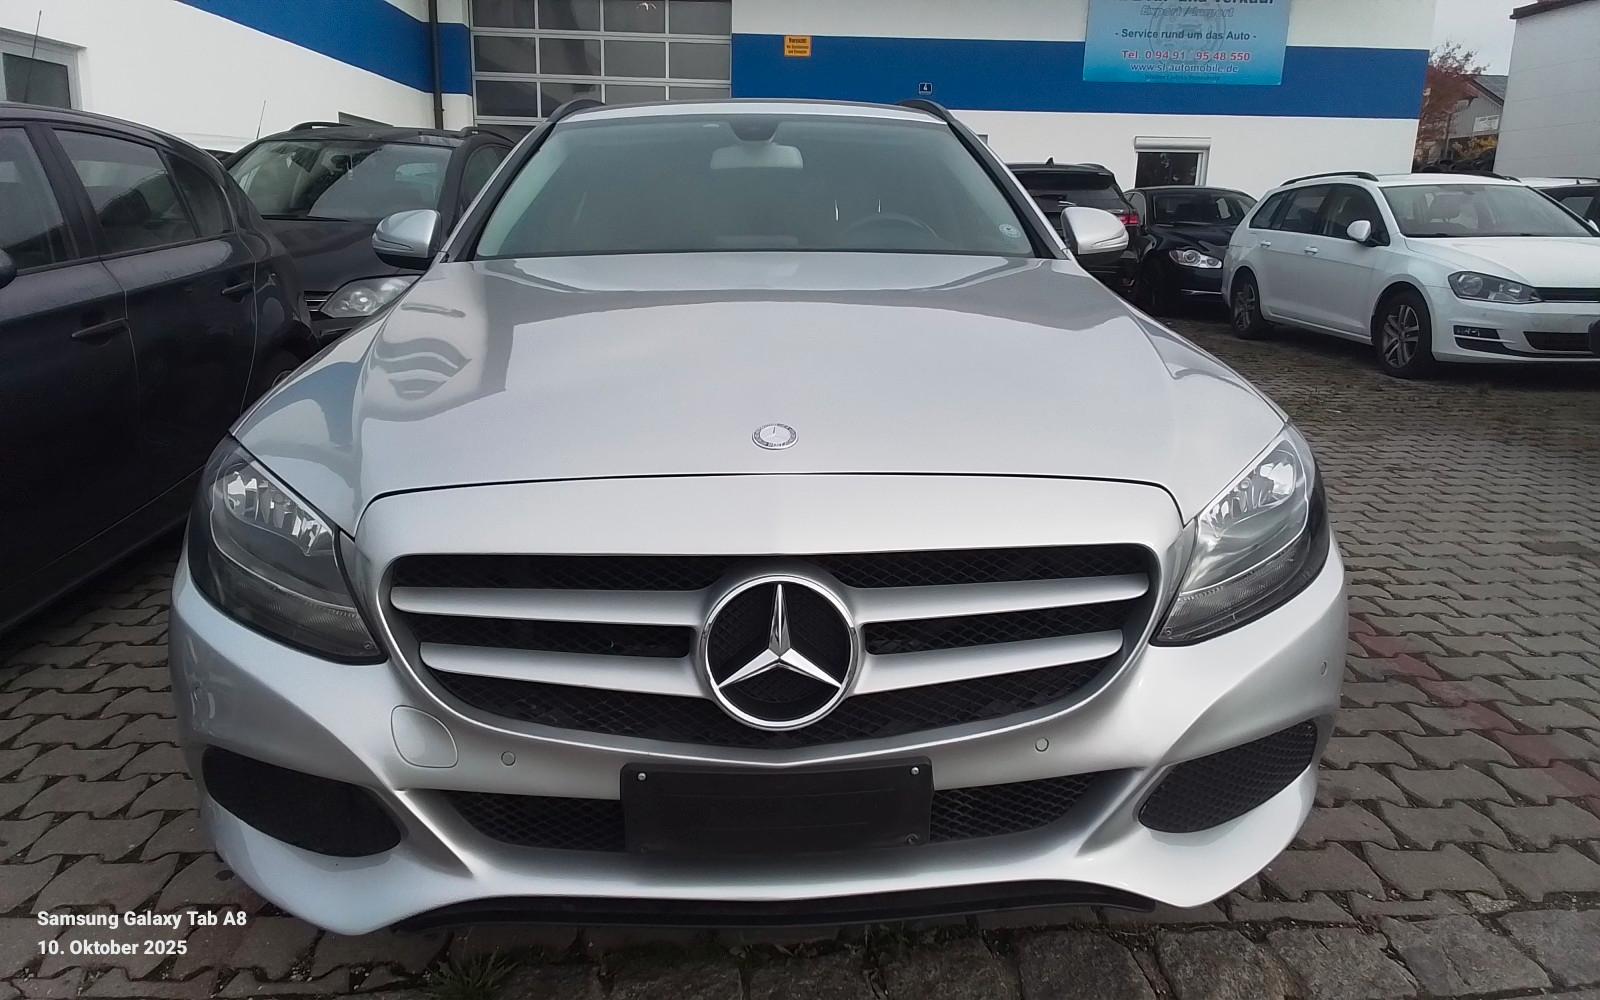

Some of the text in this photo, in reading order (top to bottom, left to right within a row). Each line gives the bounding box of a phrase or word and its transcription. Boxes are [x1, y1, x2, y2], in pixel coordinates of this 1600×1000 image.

[1121, 28, 1158, 38] Service
[1161, 30, 1185, 39] rund
[1187, 31, 1202, 40] um
[1205, 30, 1223, 40] das
[1226, 30, 1250, 40] Auto
[1230, 52, 1250, 61] 550
